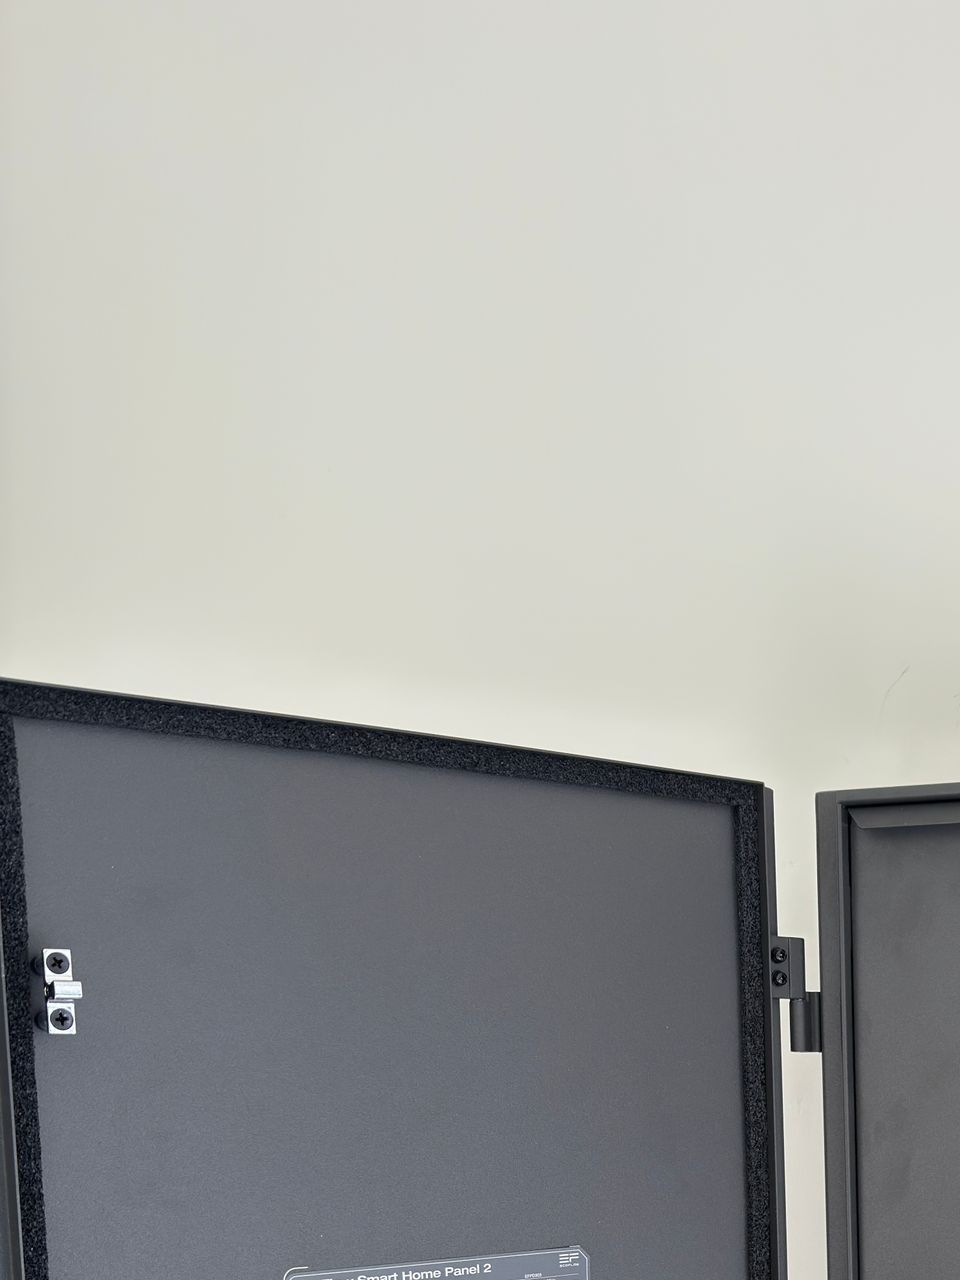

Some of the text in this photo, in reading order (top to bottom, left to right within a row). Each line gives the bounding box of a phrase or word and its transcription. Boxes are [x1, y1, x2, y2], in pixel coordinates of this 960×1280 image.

[402, 1270, 441, 1280] Home
[445, 1264, 480, 1277] Panel
[484, 1264, 492, 1272] 2
